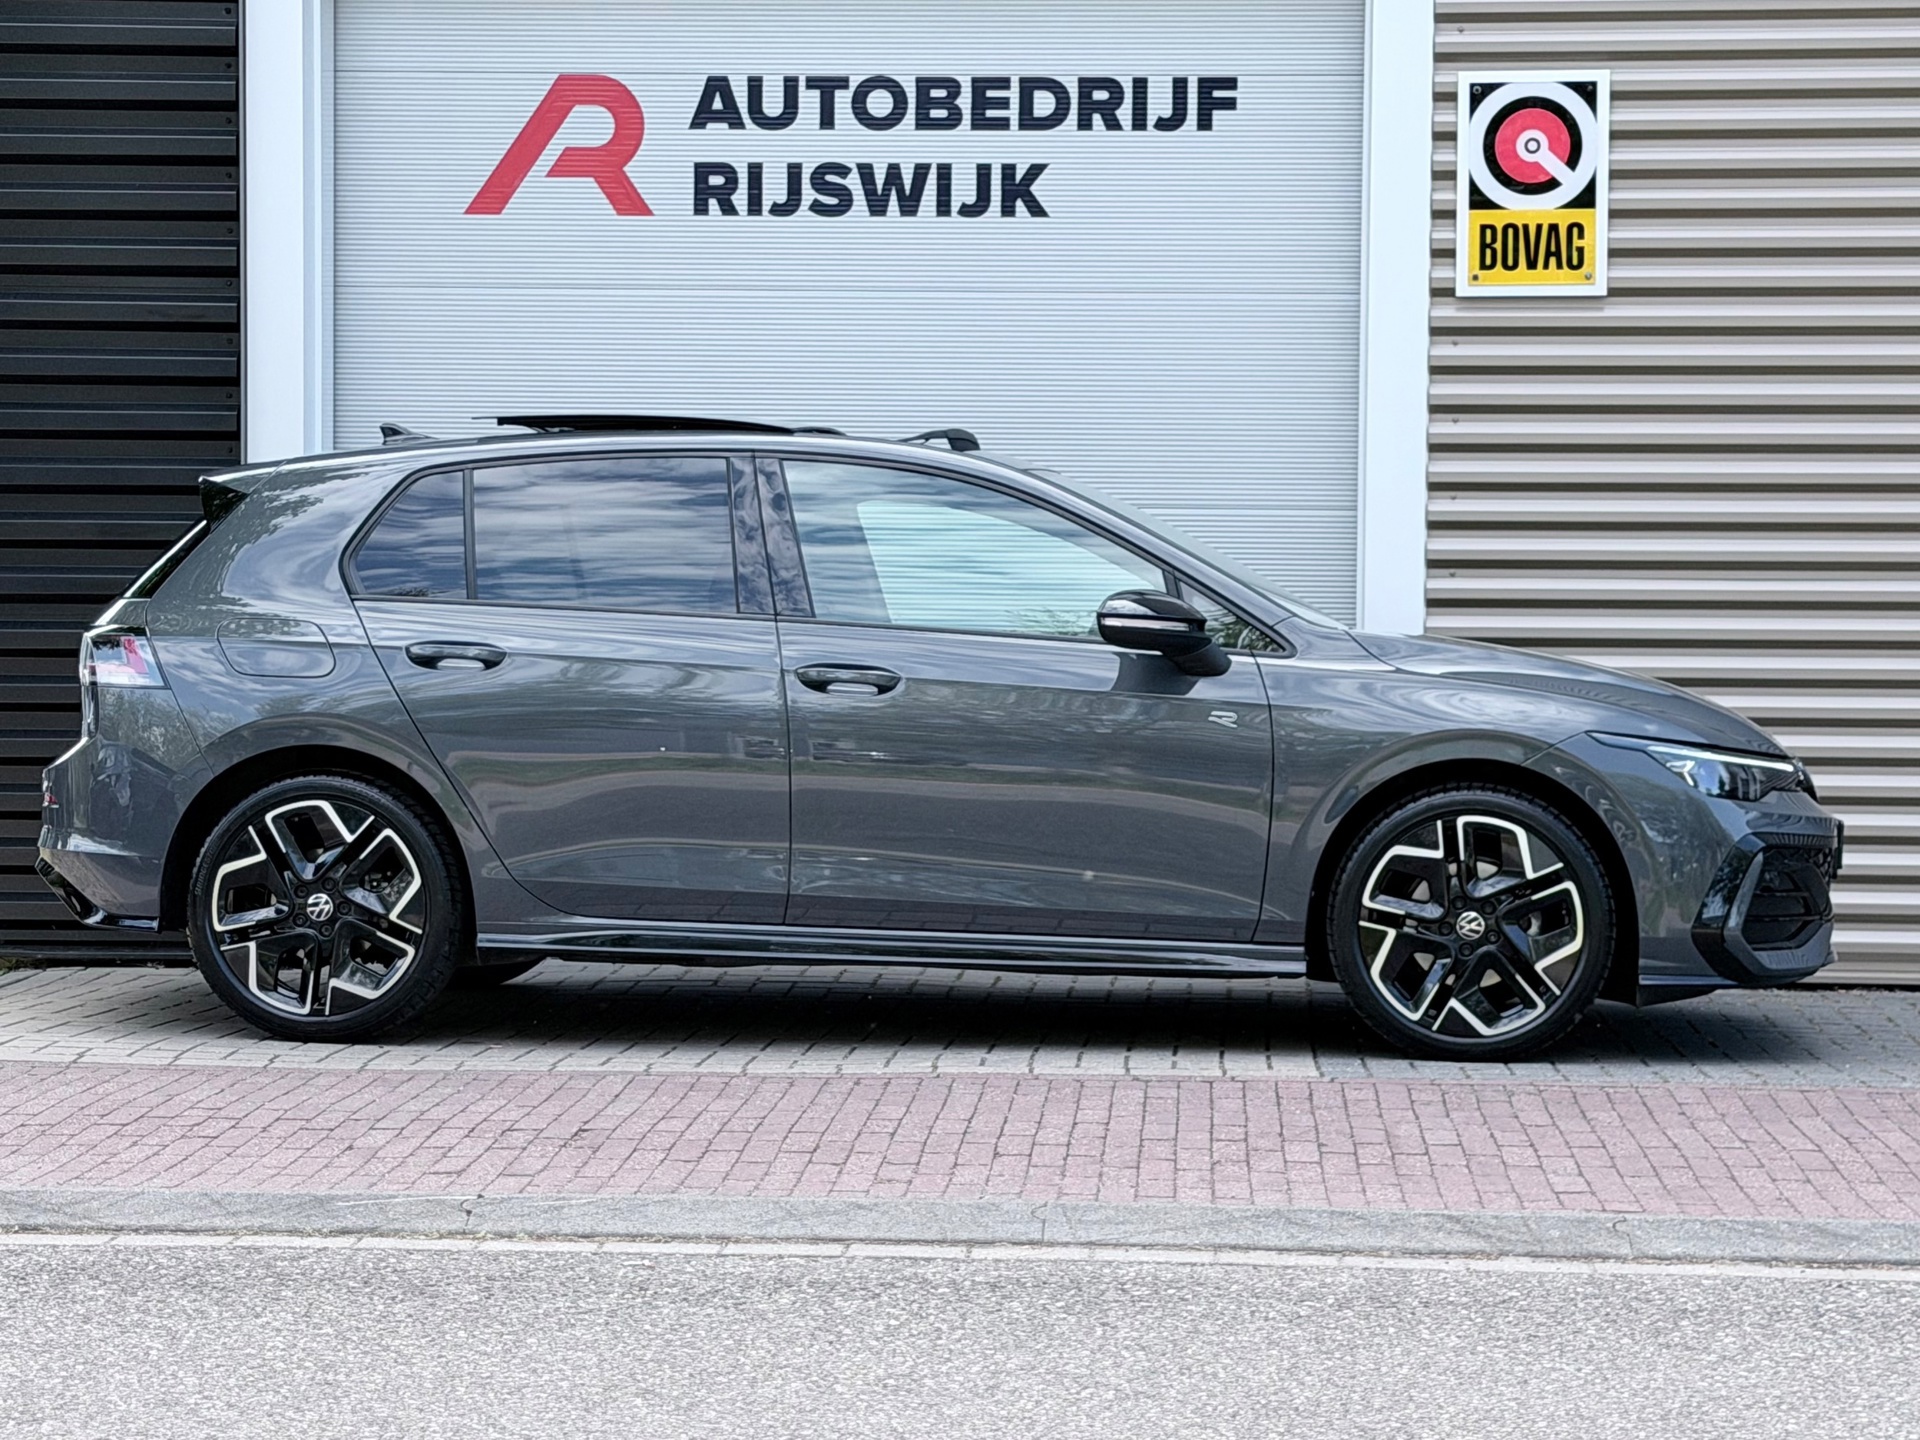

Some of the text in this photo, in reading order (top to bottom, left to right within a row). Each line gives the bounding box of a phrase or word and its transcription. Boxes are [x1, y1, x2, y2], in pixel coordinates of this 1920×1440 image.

[690, 75, 1238, 132] AUTOBEDRIJF
[693, 162, 1050, 218] RIJSWIJK
[1479, 222, 1585, 271] BOVAG
[194, 834, 222, 896] BRIDGESTO
